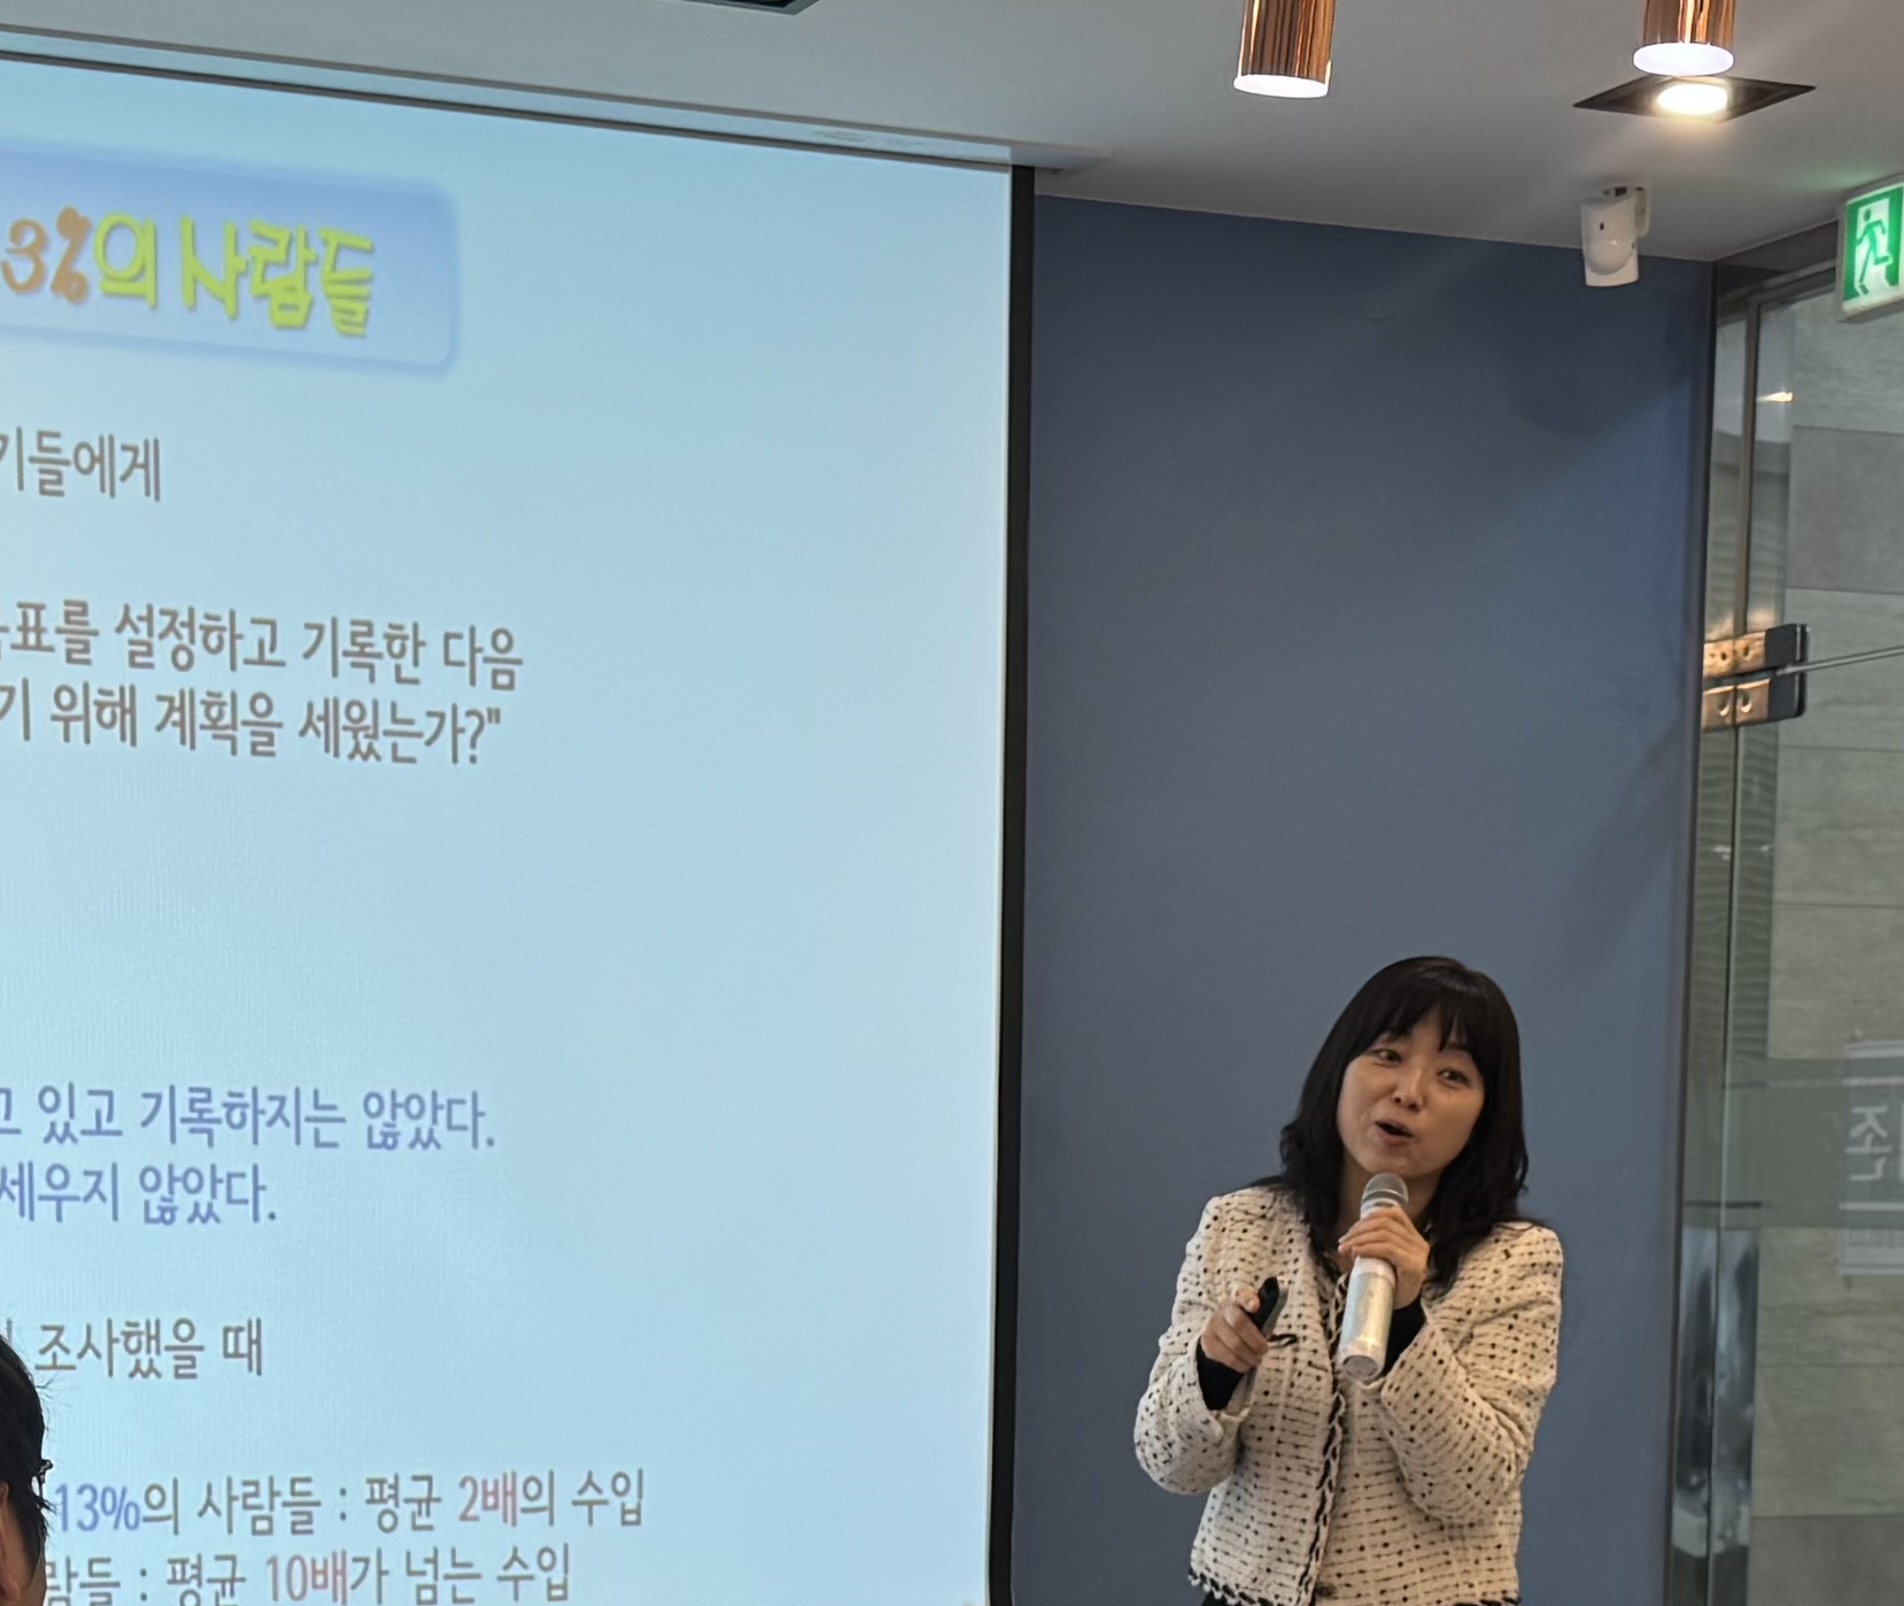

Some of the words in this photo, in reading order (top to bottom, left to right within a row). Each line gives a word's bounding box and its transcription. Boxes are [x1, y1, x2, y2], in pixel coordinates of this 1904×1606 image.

[0, 207, 158, 310] 3%의
[179, 215, 374, 337] 사람들
[115, 604, 286, 672] 설정하고
[302, 617, 426, 685] 기록한
[443, 625, 523, 691] 다음
[50, 681, 137, 747] 위해
[155, 688, 283, 757] 계획을
[299, 697, 501, 764] 세웠는가?"
[38, 1082, 123, 1144] 있고
[141, 1085, 346, 1148] 기록하지는
[363, 1089, 494, 1151] 않았다.
[139, 1163, 276, 1226] 않았다.
[35, 1318, 205, 1379] 조사했을
[223, 1318, 262, 1376] 때
[56, 1477, 179, 1536] 13%의
[197, 1476, 322, 1536] 사람들
[365, 1473, 442, 1534] 평균
[459, 1470, 554, 1527] 2배의
[571, 1468, 643, 1527] 수입
[266, 1547, 390, 1606] 10배가
[406, 1547, 482, 1606] 넘는
[497, 1543, 569, 1602] 수입
